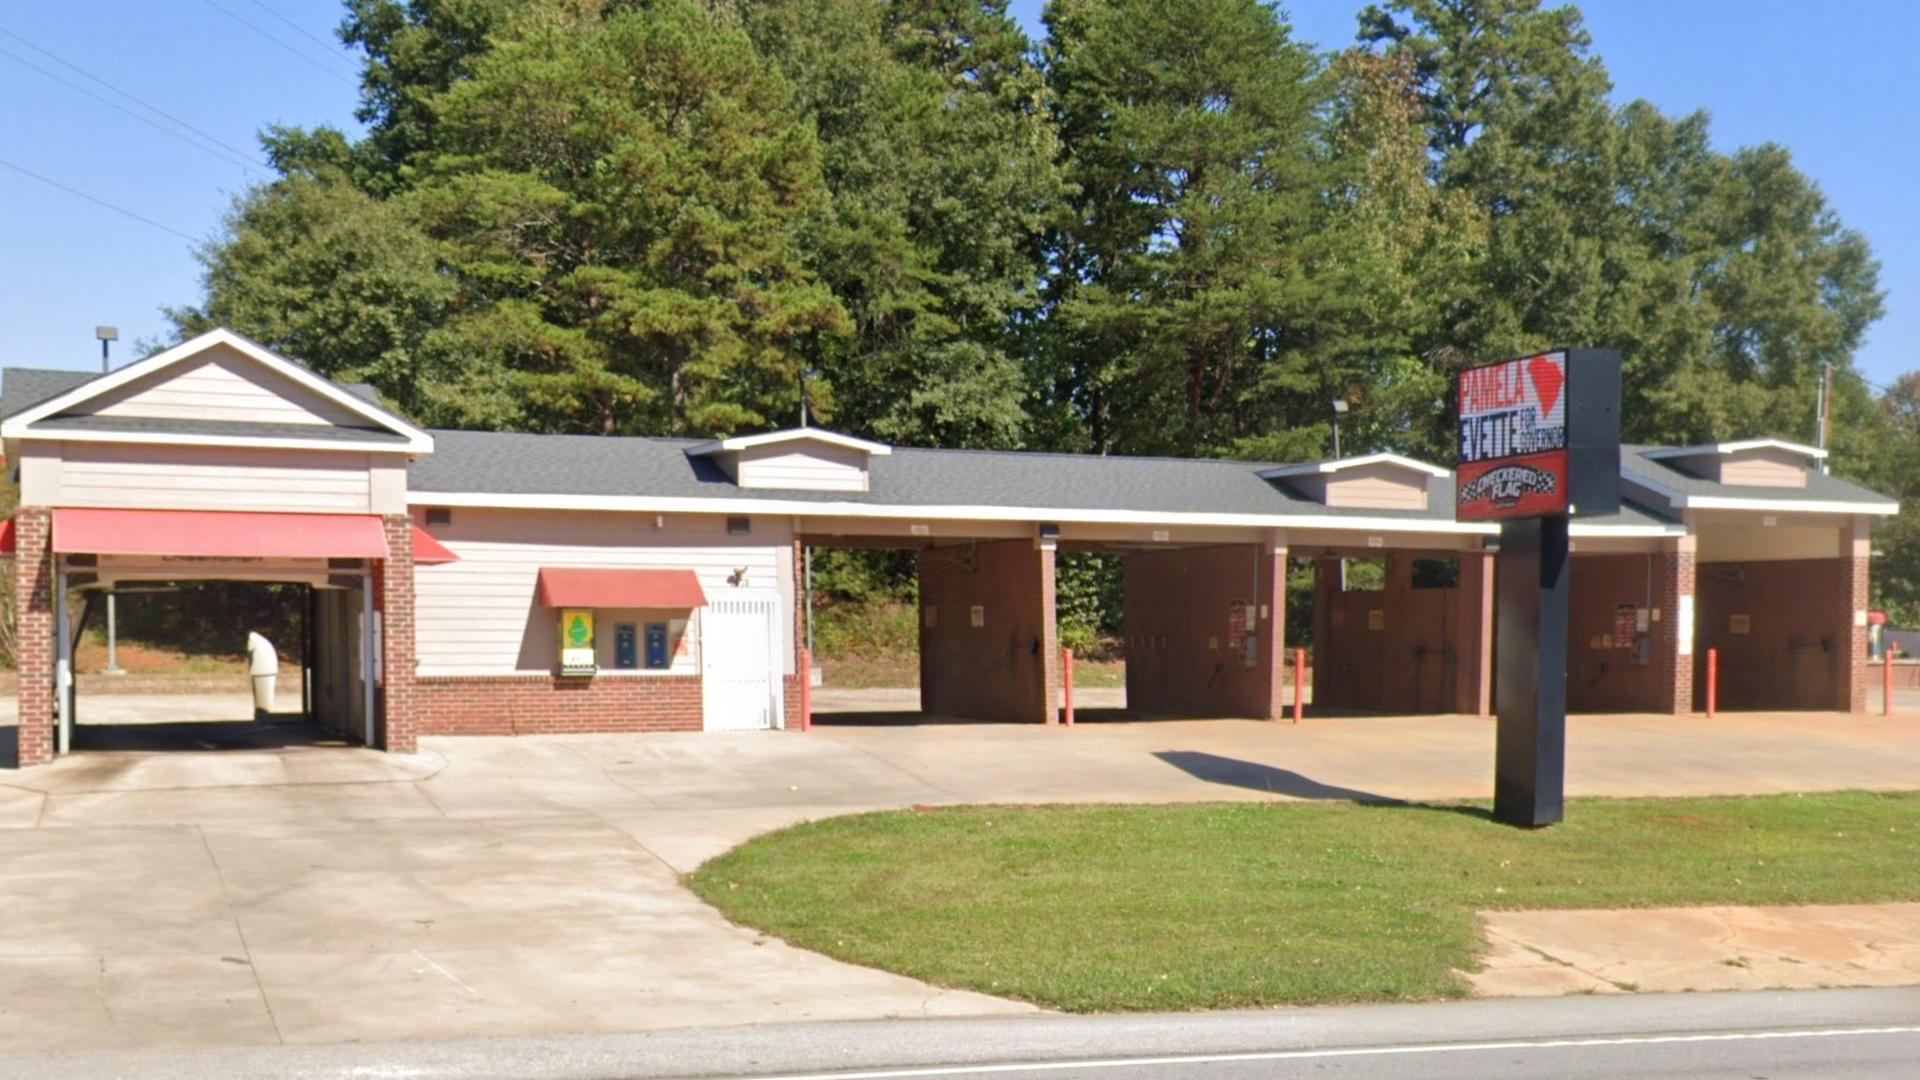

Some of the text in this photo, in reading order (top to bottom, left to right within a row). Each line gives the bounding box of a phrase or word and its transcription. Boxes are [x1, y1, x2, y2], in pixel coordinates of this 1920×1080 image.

[1460, 359, 1526, 415] PAMELA
[1520, 406, 1536, 430] FOR
[1460, 409, 1520, 463] EVETTE
[1520, 426, 1565, 453] GOVERNOR
[1477, 467, 1537, 493] CHECKERED
[1491, 481, 1521, 500] FLAG
